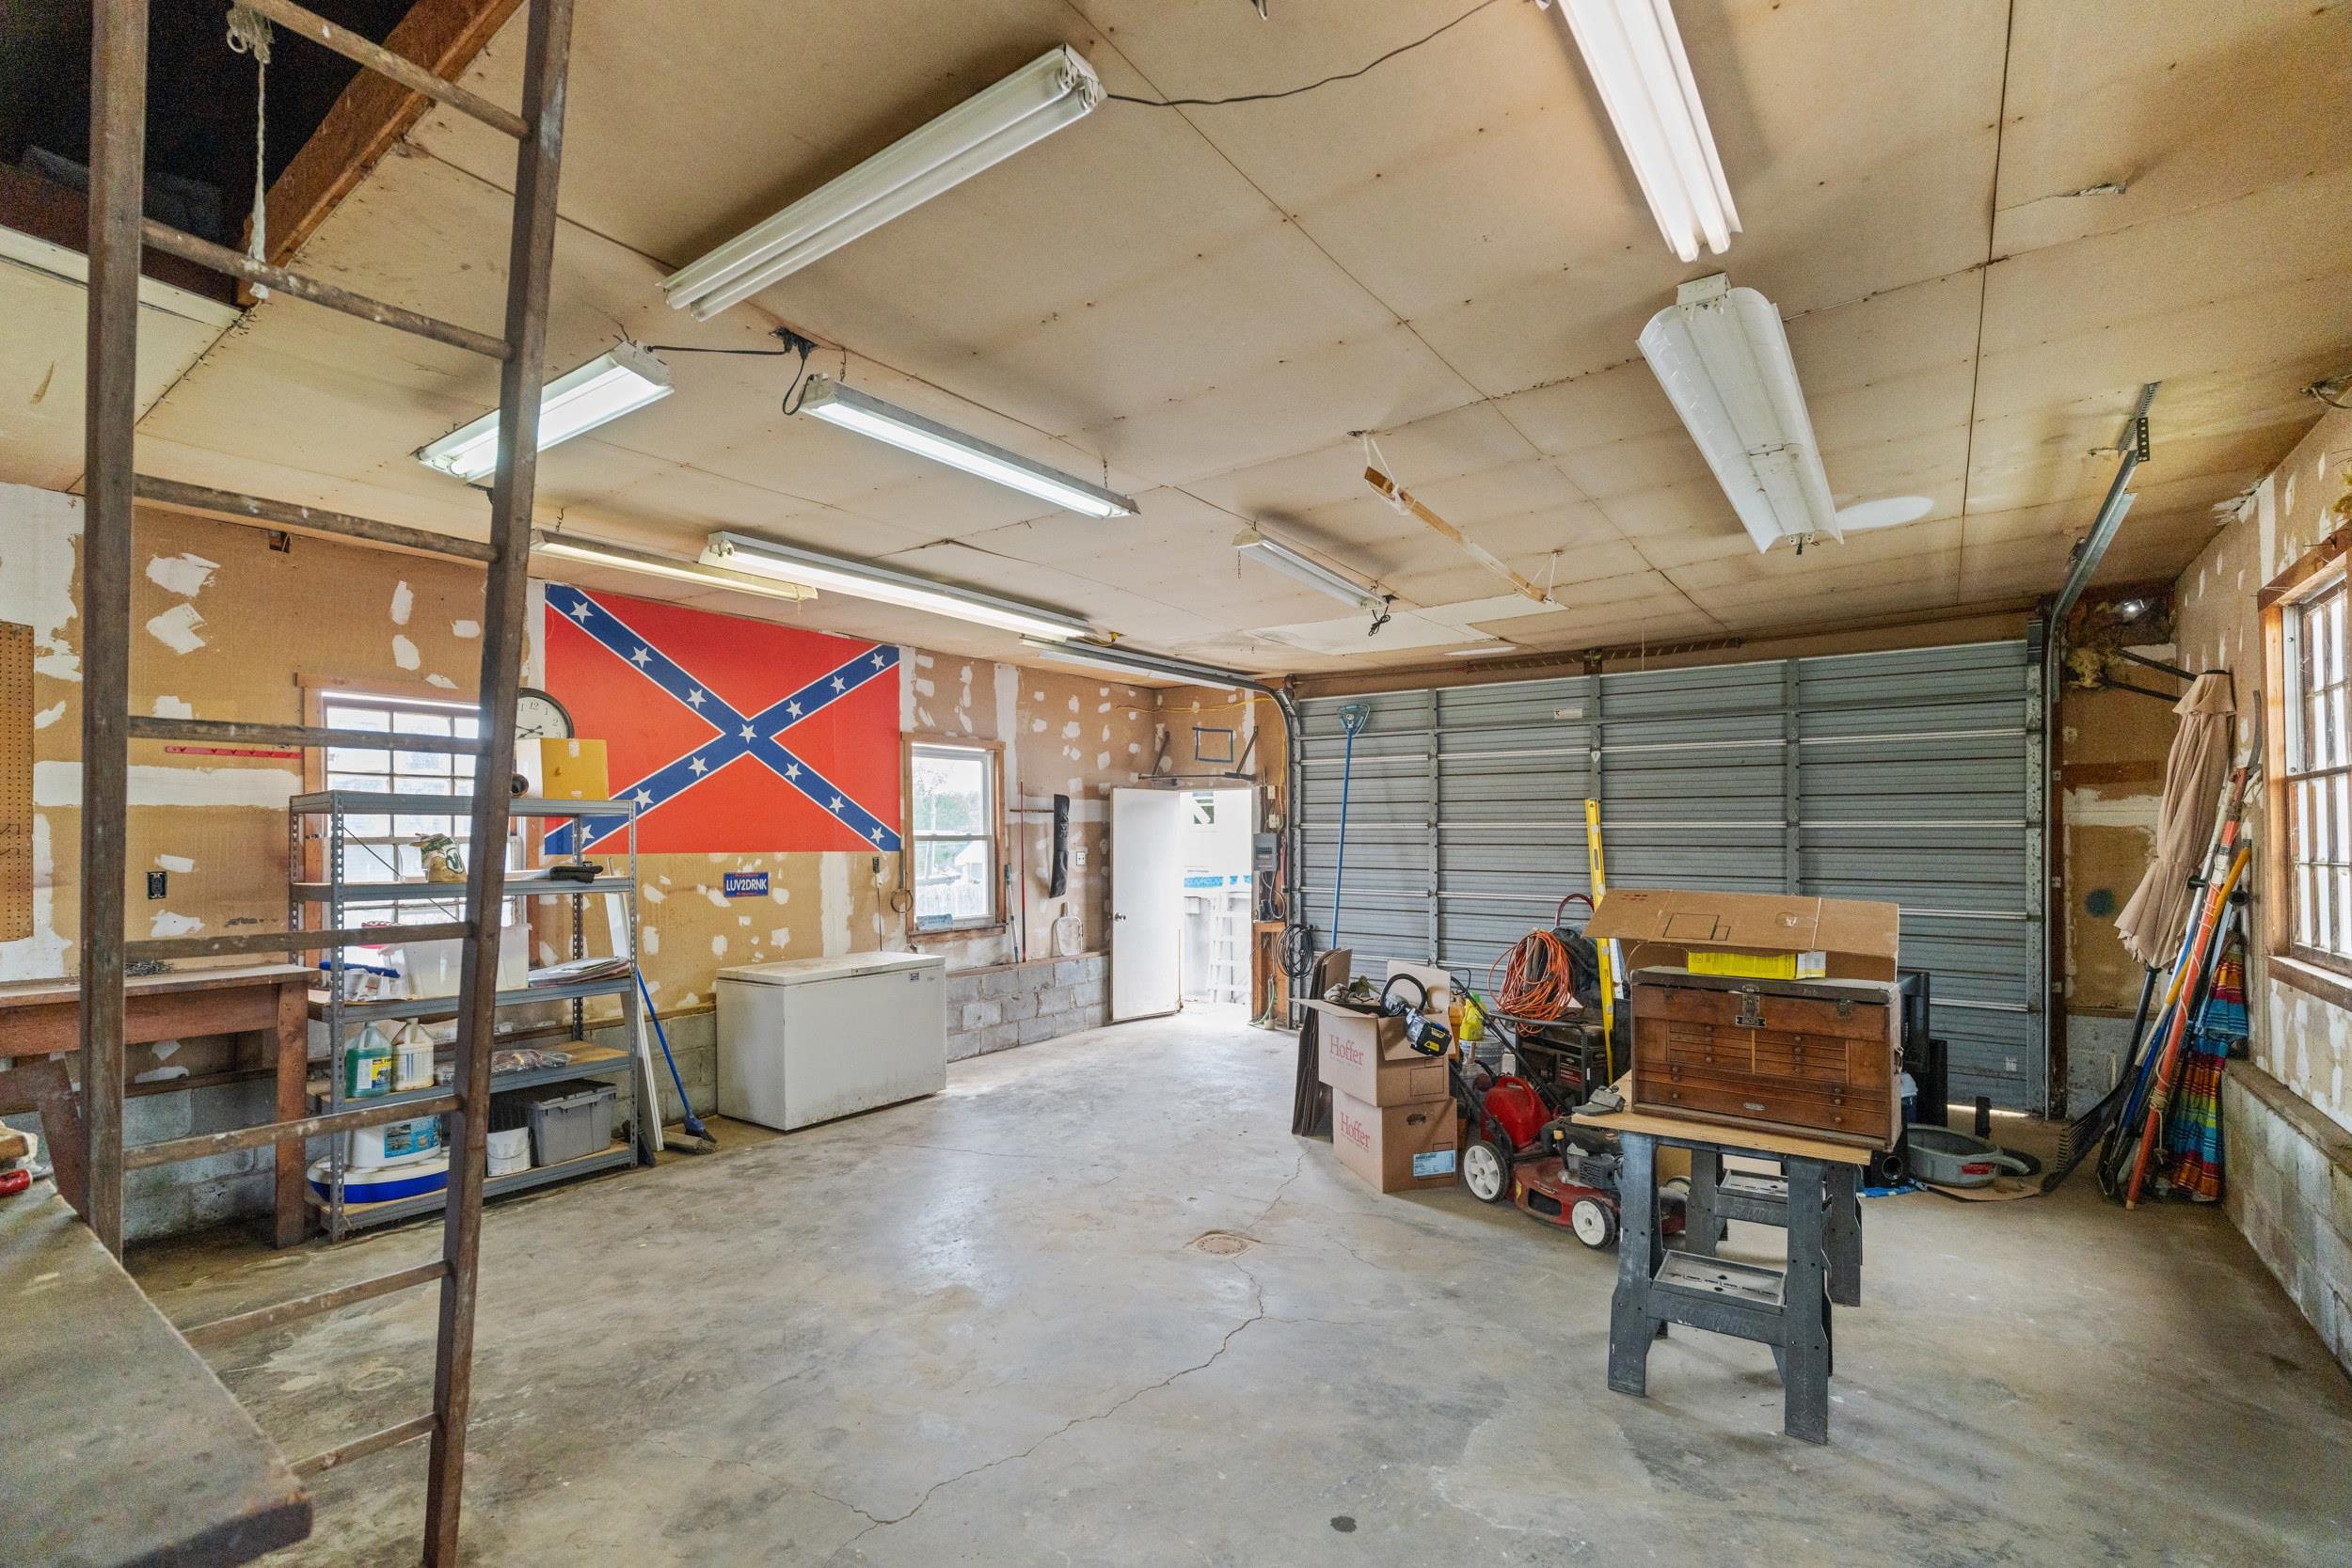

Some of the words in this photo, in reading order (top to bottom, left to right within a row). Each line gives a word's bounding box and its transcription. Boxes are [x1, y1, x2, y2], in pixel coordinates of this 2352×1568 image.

[726, 879, 767, 891] LUV2DRNK
[1329, 1035, 1364, 1066] Hoffer
[1341, 1112, 1370, 1148] Hoffer
